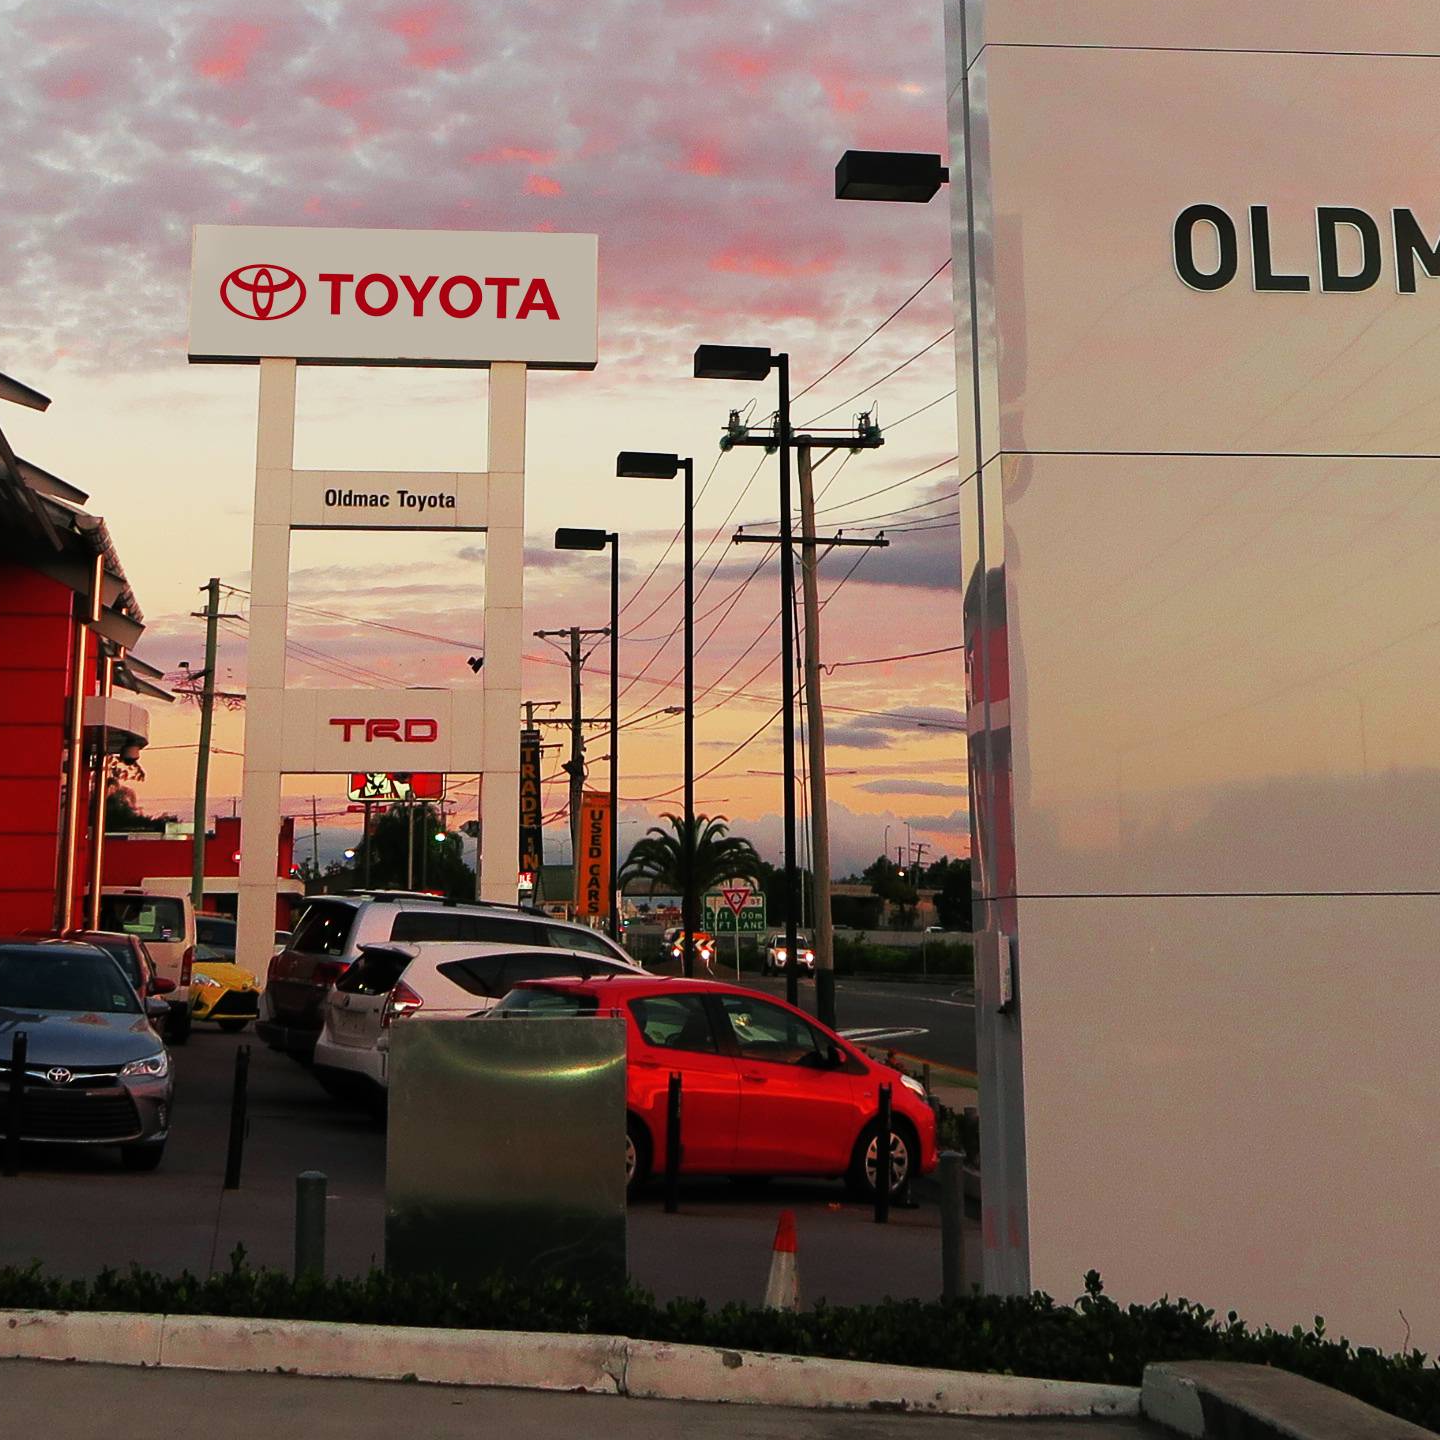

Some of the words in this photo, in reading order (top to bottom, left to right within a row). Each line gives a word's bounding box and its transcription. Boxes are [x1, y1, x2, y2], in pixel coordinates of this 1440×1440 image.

[319, 272, 561, 321] TOYOTA
[325, 489, 390, 509] Oldmac
[397, 489, 456, 512] Toyota
[329, 718, 438, 743] TRD
[521, 747, 537, 825] TRADE
[589, 810, 603, 858] USED
[588, 864, 601, 913] CARS
[706, 911, 728, 920] EIT
